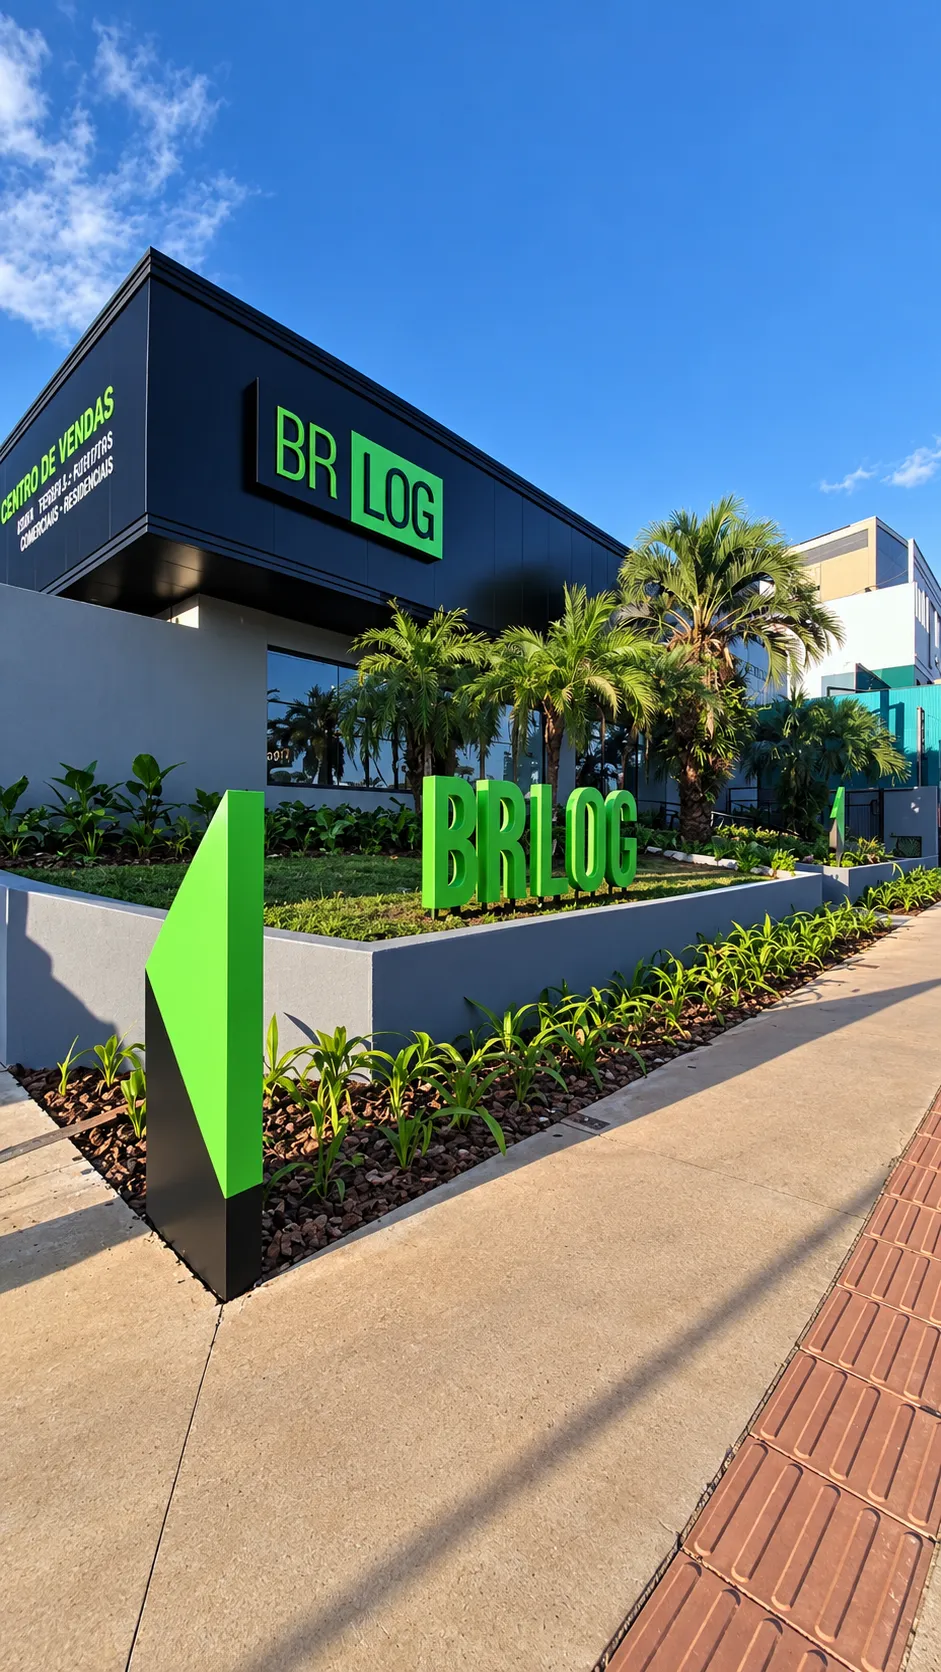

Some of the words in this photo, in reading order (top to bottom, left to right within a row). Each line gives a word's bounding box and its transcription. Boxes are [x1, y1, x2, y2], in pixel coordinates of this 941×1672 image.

[0, 465, 39, 525] CENTRO
[41, 445, 57, 485] DE
[58, 385, 115, 464] VENDAS
[63, 456, 114, 515] RESIDENCIAIS
[276, 405, 338, 500] BR
[363, 452, 435, 542] LOG
[421, 775, 638, 909] BRLOG
